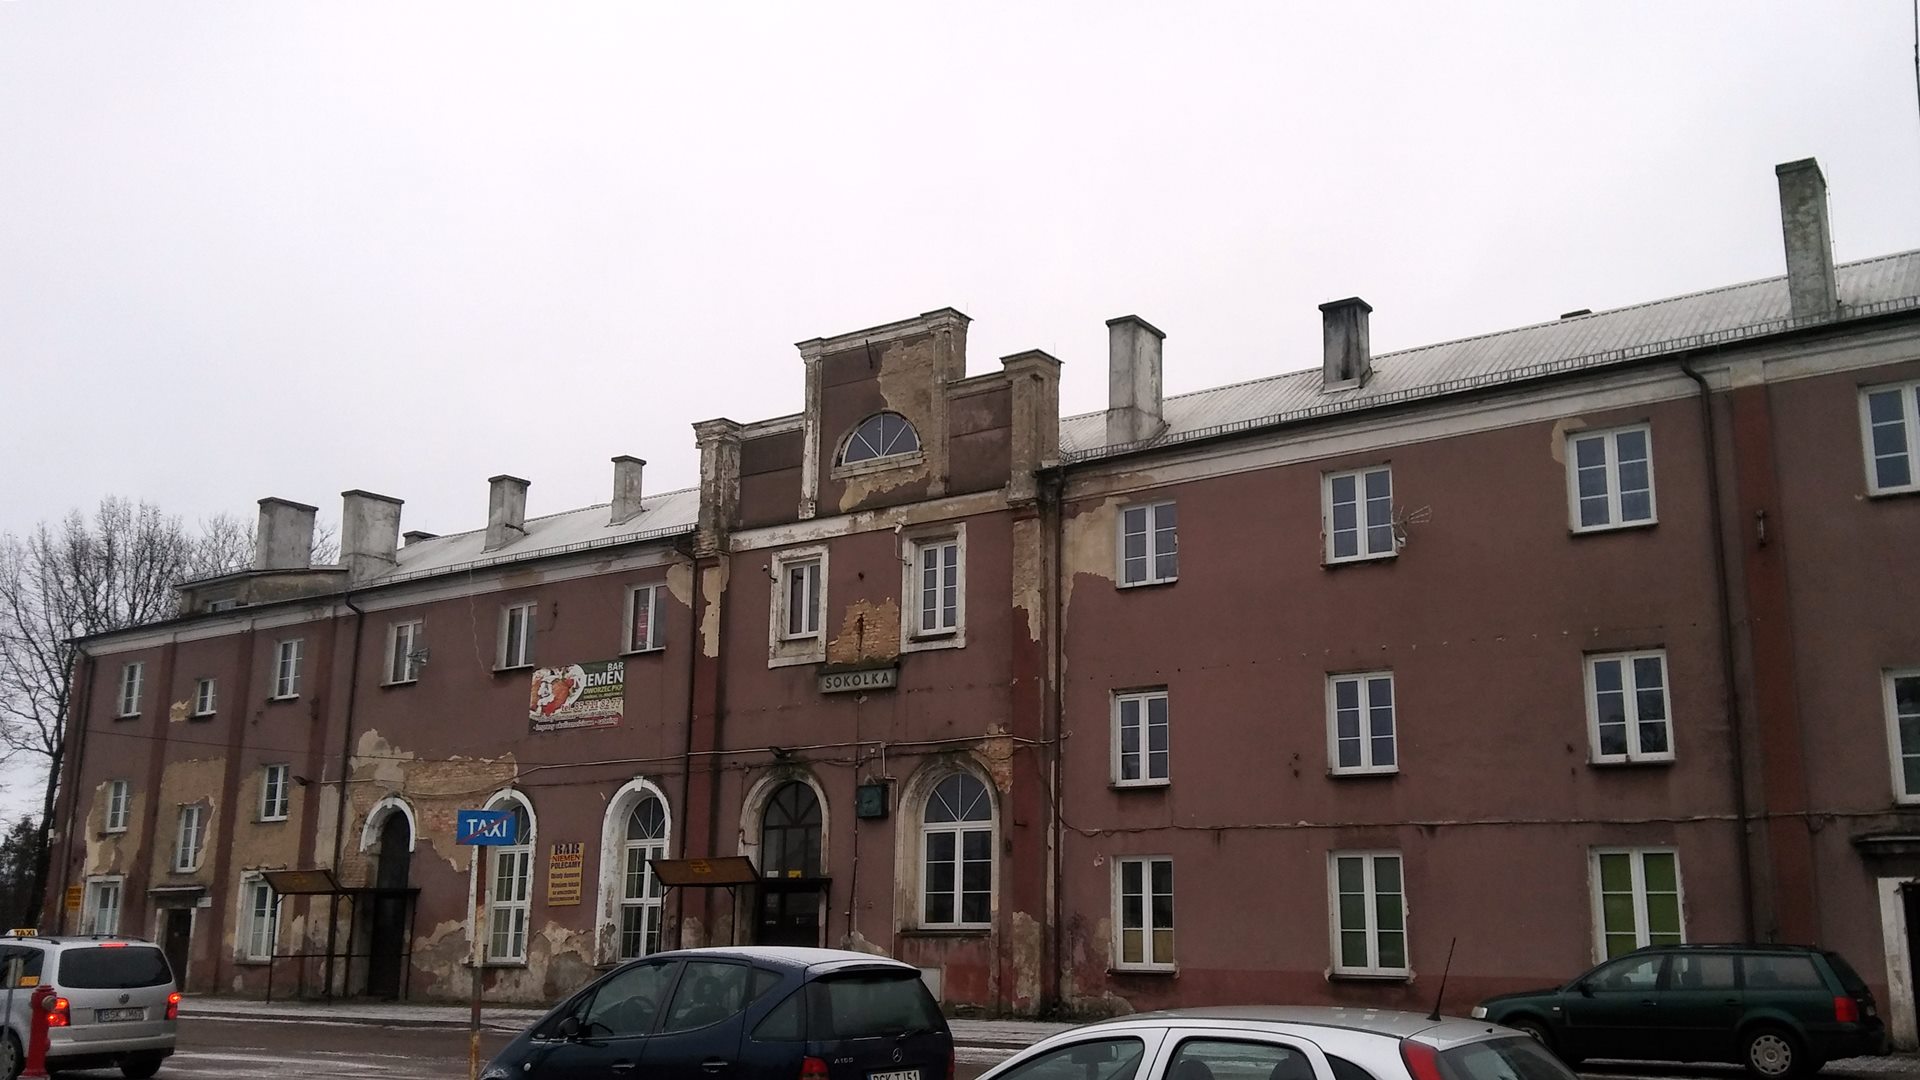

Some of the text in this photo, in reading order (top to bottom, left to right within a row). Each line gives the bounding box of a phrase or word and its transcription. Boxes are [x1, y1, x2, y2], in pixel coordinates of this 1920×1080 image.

[607, 661, 624, 672] BAR
[584, 685, 611, 694] DWORZEC
[574, 701, 584, 711] 85
[466, 818, 506, 837] TAXI
[554, 843, 580, 855] BAR
[552, 854, 580, 862] NIEMEN
[551, 861, 581, 869] POLECAMY
